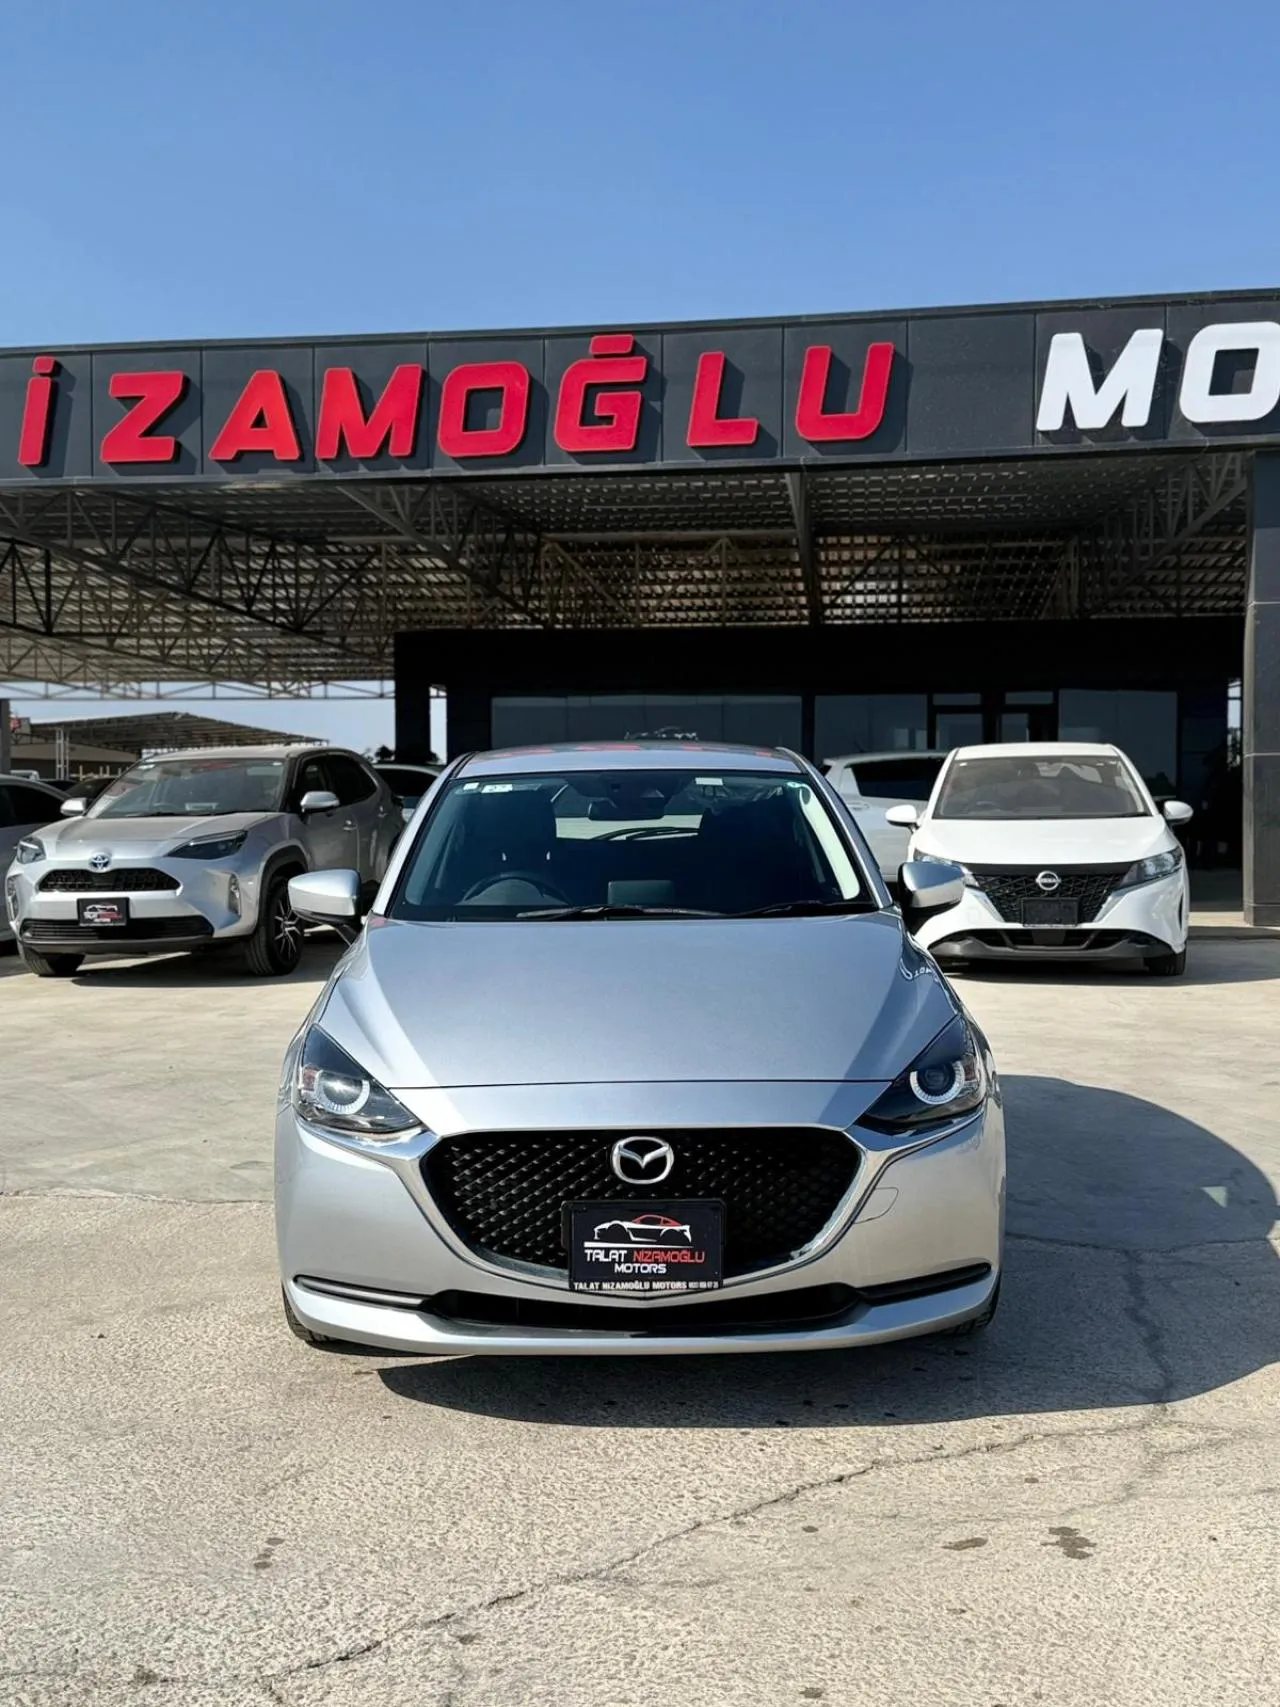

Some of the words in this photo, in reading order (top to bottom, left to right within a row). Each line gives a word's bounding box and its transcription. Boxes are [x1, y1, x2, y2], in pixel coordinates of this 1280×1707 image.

[584, 1249, 628, 1262] TALAT
[614, 1263, 668, 1274] MOTORS
[573, 1281, 600, 1291] TALAT
[652, 1281, 688, 1290] MOTORS
